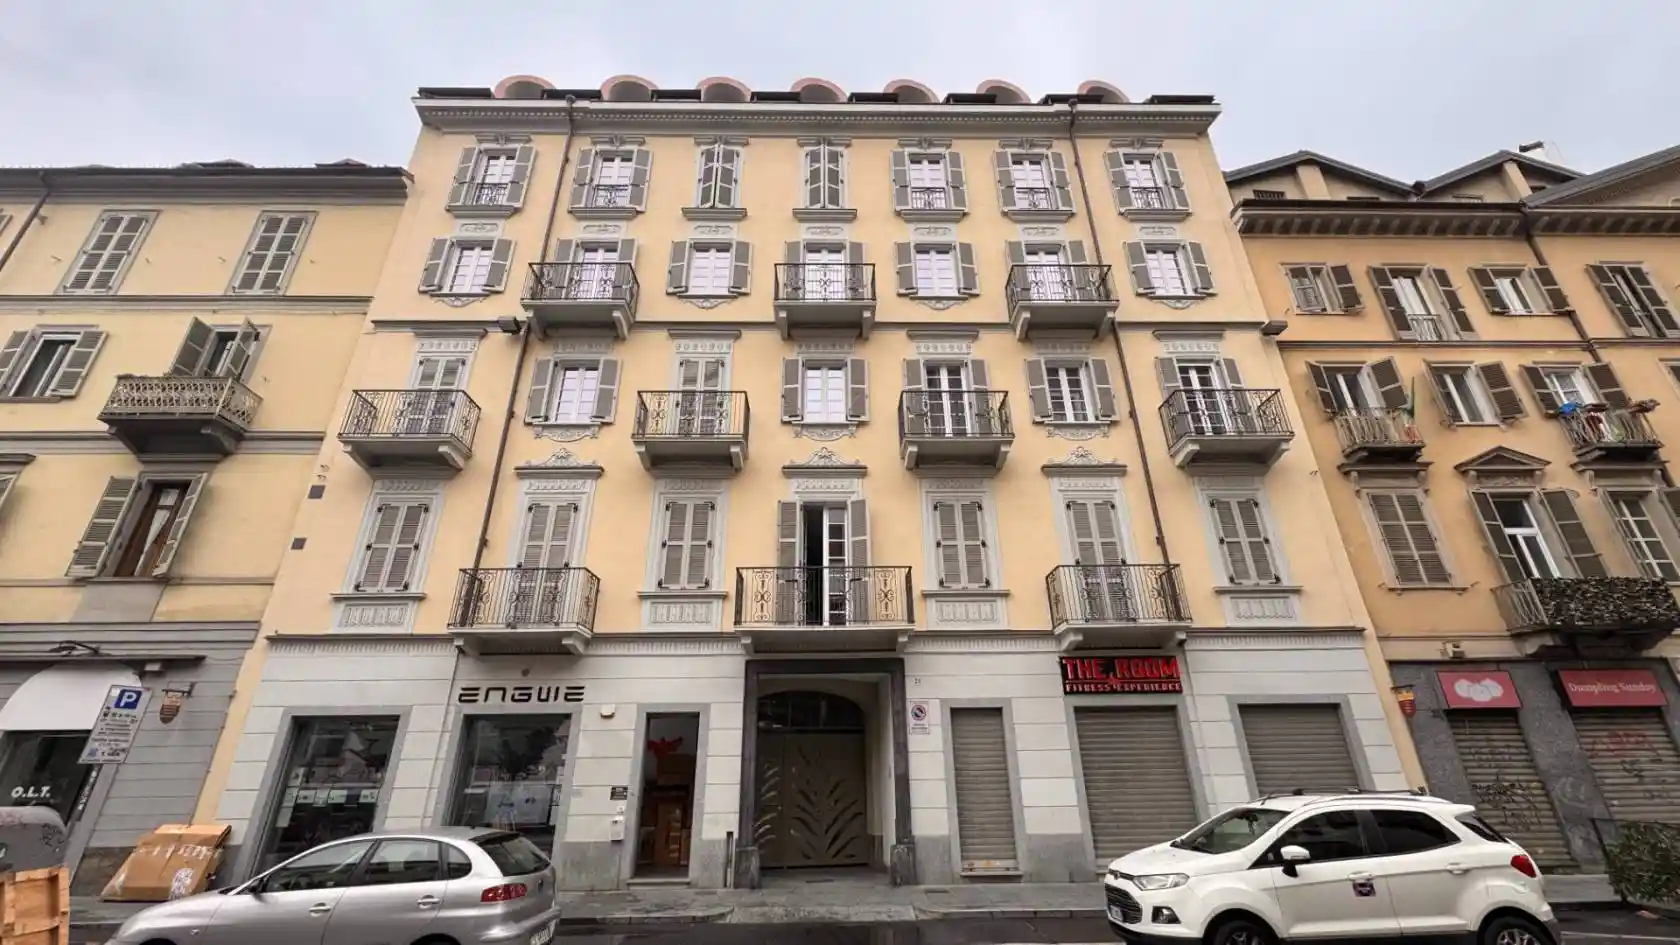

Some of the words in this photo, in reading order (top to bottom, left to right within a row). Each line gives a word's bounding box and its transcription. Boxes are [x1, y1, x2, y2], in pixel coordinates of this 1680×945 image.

[1063, 656, 1106, 679] THE
[1115, 656, 1182, 679] ROOM
[1065, 683, 1111, 693] FITNESS
[1117, 682, 1181, 693] EXPERIENCE
[1568, 681, 1620, 696] Dumpling
[1619, 681, 1656, 694] Sunday
[119, 691, 137, 708] P
[11, 785, 51, 798] O.L.T.
